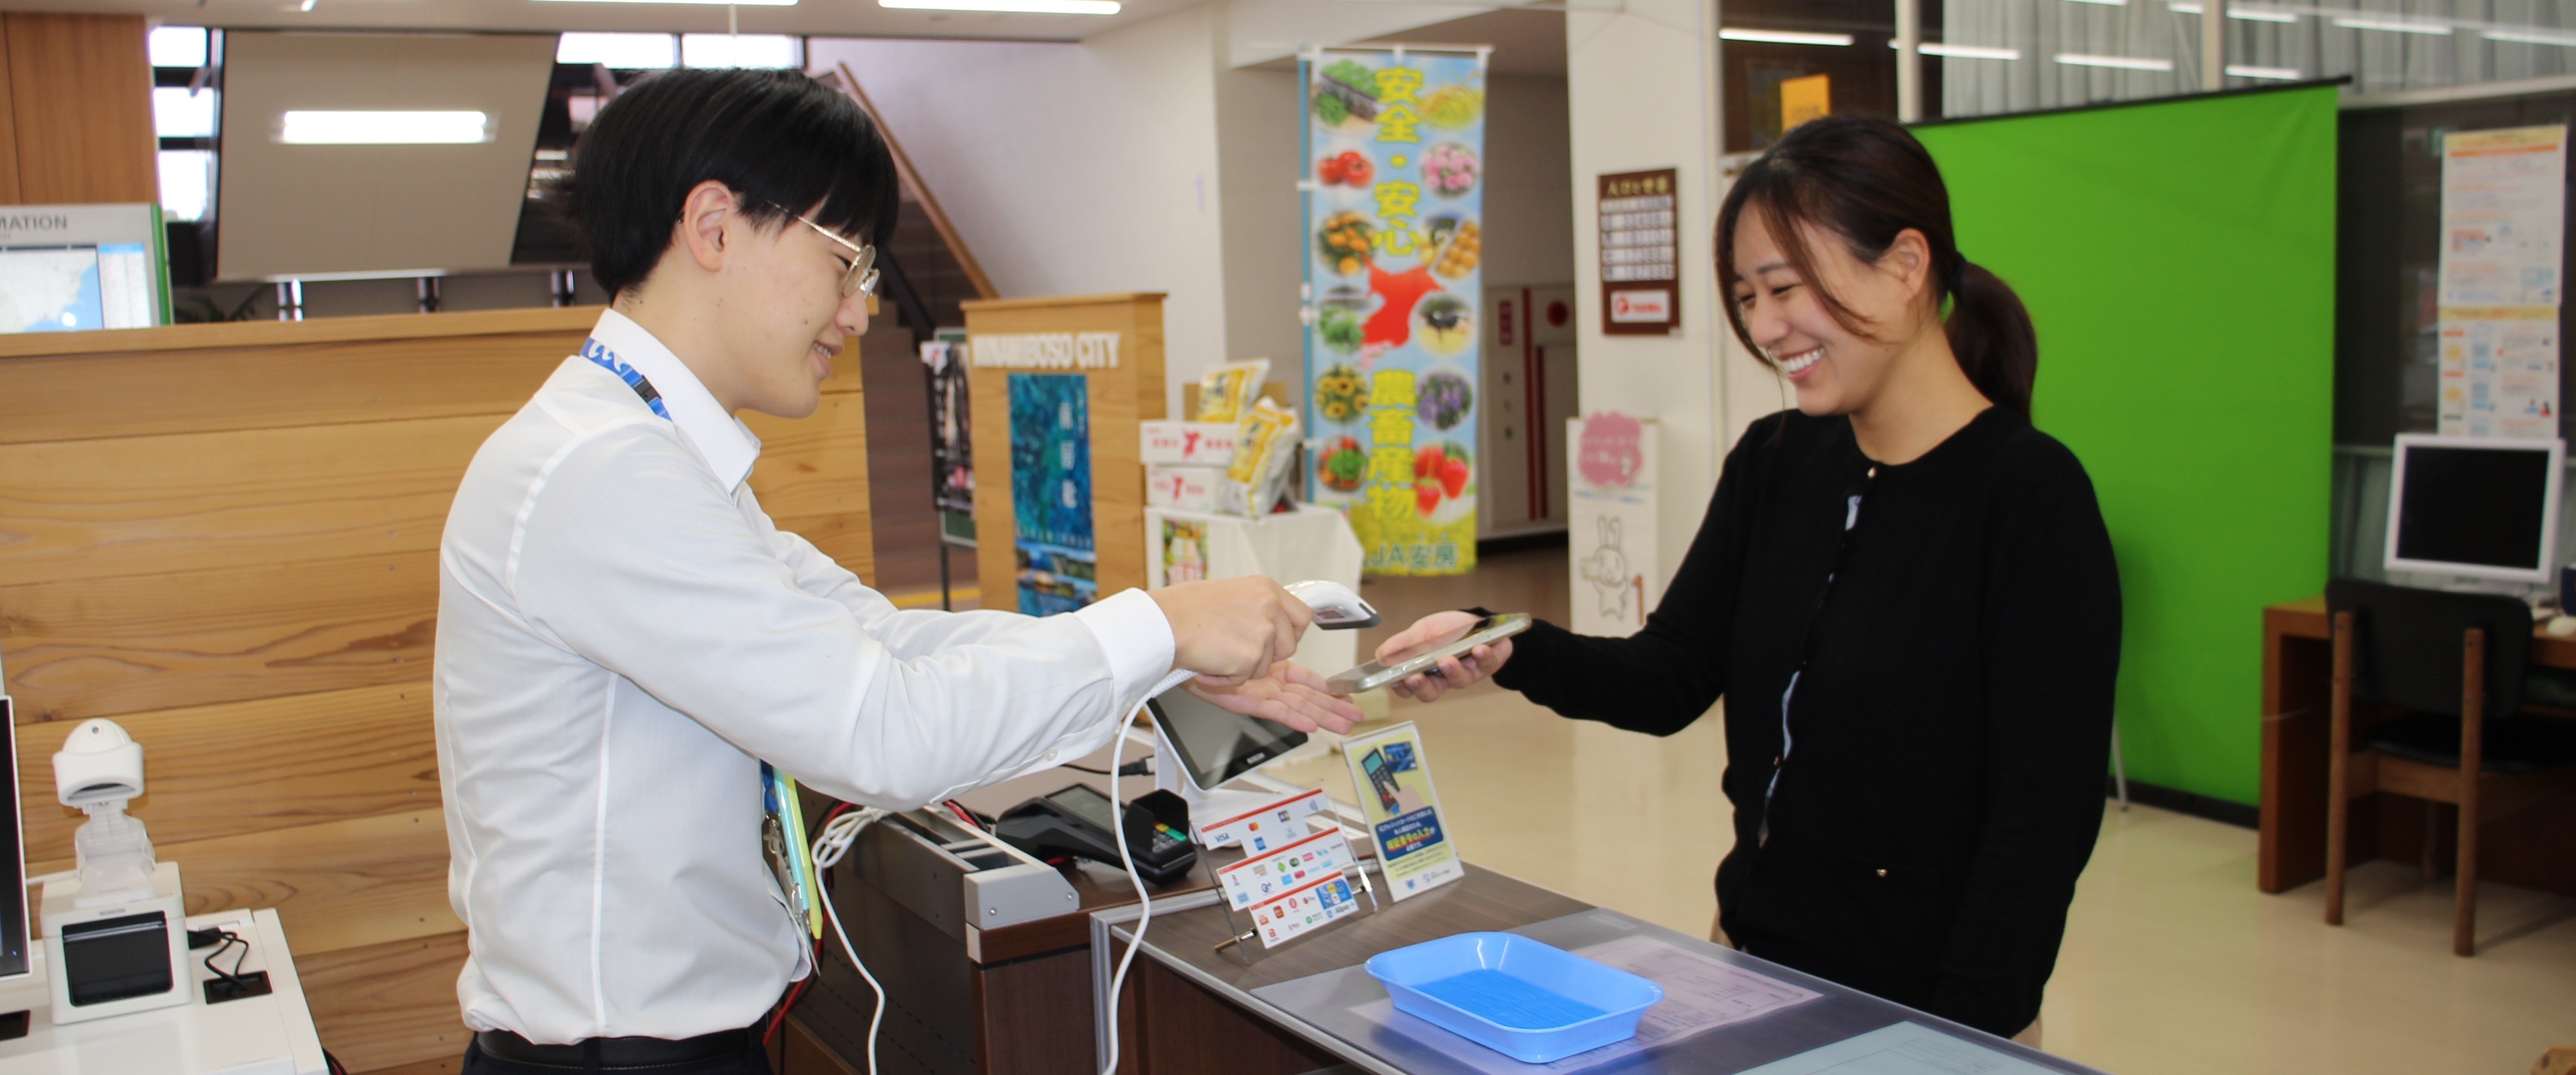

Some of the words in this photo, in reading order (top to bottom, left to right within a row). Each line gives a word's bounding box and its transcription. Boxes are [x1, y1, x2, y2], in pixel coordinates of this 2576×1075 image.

[1373, 65, 1424, 256] 安全・安心
[1076, 332, 1121, 368] CITY
[1365, 369, 1417, 519] 農畜産物
[1214, 832, 1230, 843] VISA
